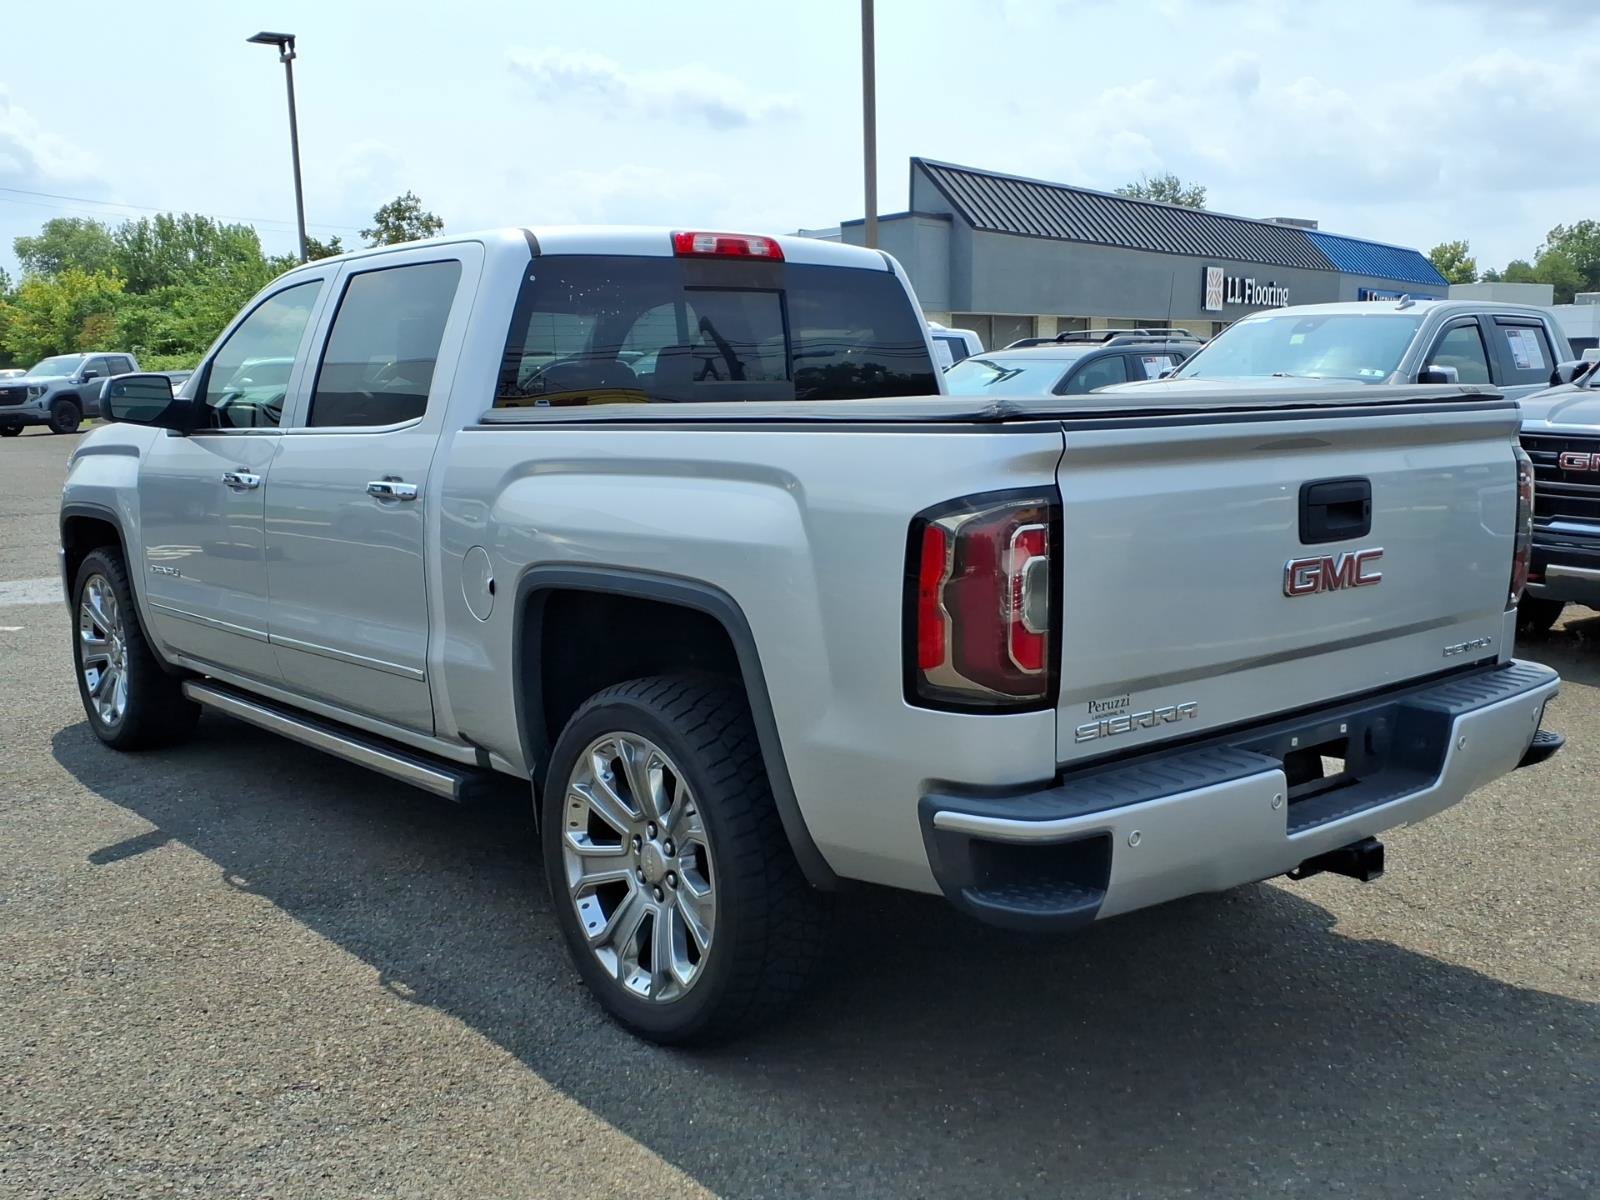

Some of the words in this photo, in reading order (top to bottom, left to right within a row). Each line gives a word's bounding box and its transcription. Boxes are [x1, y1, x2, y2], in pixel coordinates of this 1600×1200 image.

[1227, 277, 1242, 303] LL
[1244, 278, 1289, 308] Flooring
[1283, 547, 1384, 597] GMC
[1088, 693, 1130, 713] Peruzzi
[1075, 701, 1198, 743] SIERRA
